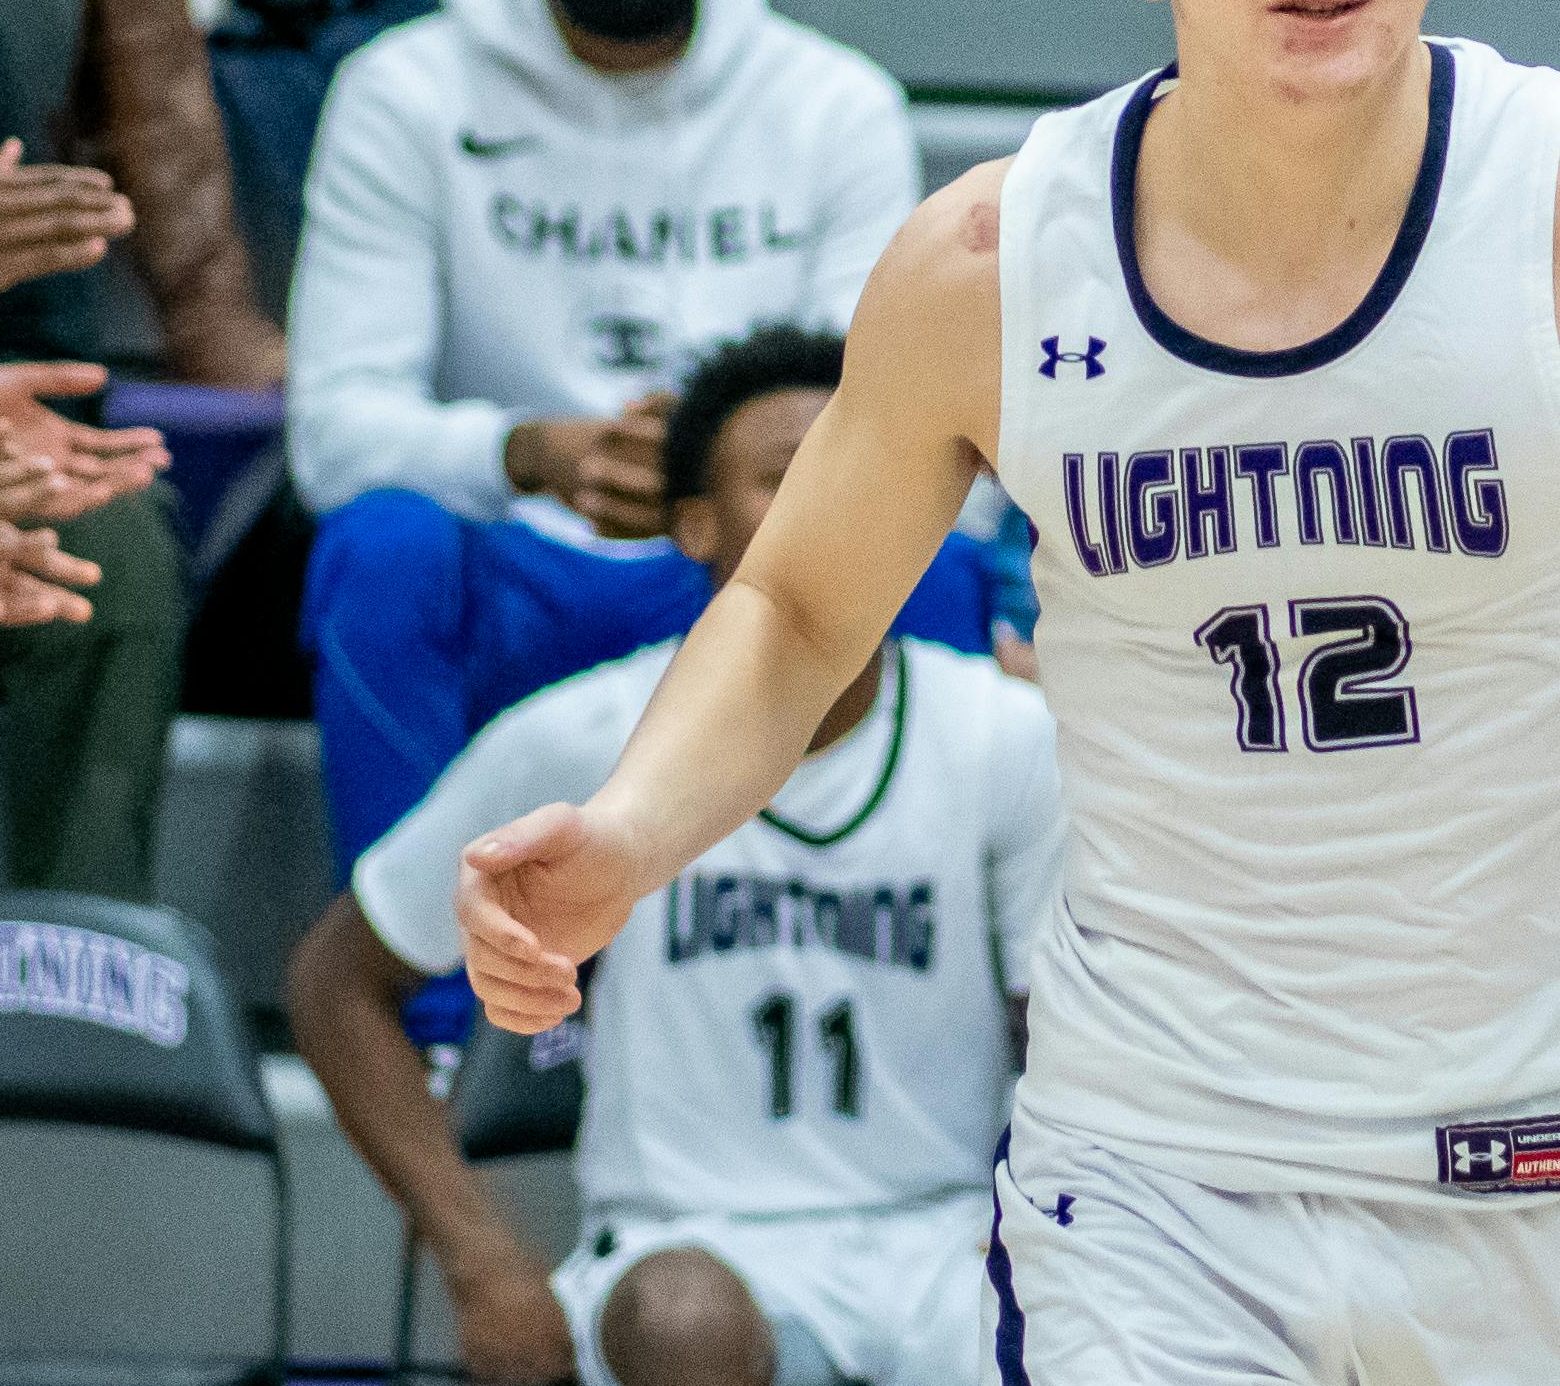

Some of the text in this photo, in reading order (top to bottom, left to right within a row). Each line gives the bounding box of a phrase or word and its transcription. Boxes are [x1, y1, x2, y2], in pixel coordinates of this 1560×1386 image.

[488, 191, 807, 264] CHANEL
[1062, 427, 1510, 579] LIGHTNING
[1193, 594, 1421, 754] 12
[747, 988, 866, 1122] 11
[1517, 1132, 1560, 1144] UNDER
